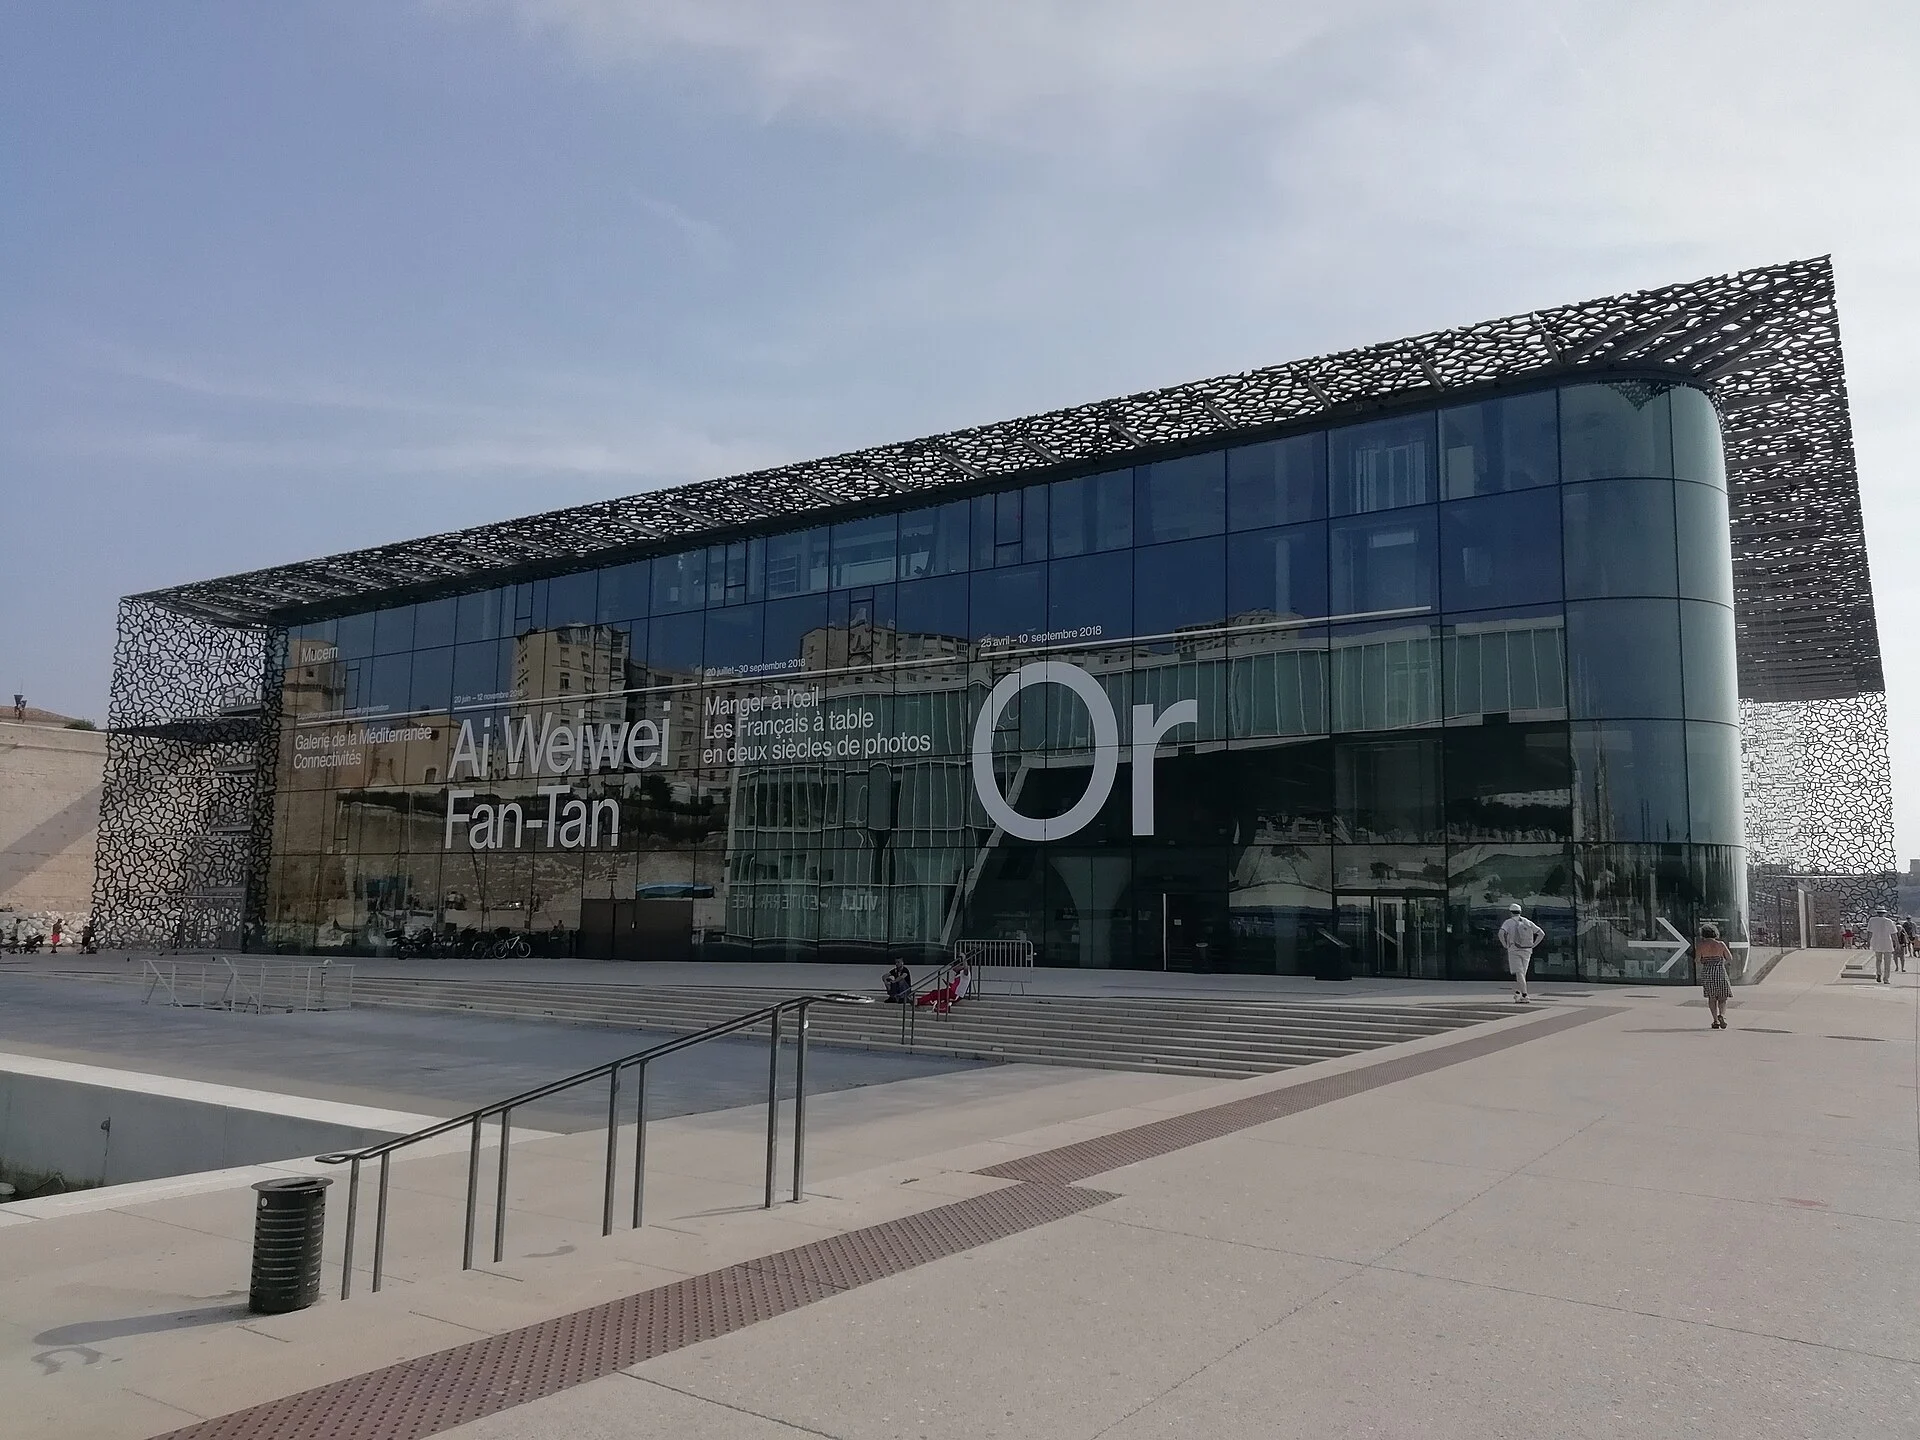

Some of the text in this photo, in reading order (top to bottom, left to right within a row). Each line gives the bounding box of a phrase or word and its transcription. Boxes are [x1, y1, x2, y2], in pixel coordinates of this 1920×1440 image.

[981, 638, 992, 648] 25
[993, 635, 1010, 646] avril
[1018, 633, 1028, 644] 10
[1031, 627, 1078, 643] septembre
[1079, 625, 1102, 637] 2018
[301, 646, 338, 663] Mucem
[706, 668, 717, 677] 20
[749, 660, 787, 673] septembre
[788, 658, 806, 669] 2018
[705, 695, 767, 717] Manger
[771, 690, 782, 710] à
[295, 724, 432, 750] Galerie de la Méditerranée
[703, 708, 874, 740] Les Français à table
[447, 701, 671, 779] Ai Weiwei
[703, 732, 931, 764] en deux siècles de photos
[972, 660, 1198, 842] Or
[294, 748, 361, 769] Connectivités
[444, 784, 620, 849] Fan-Tan
